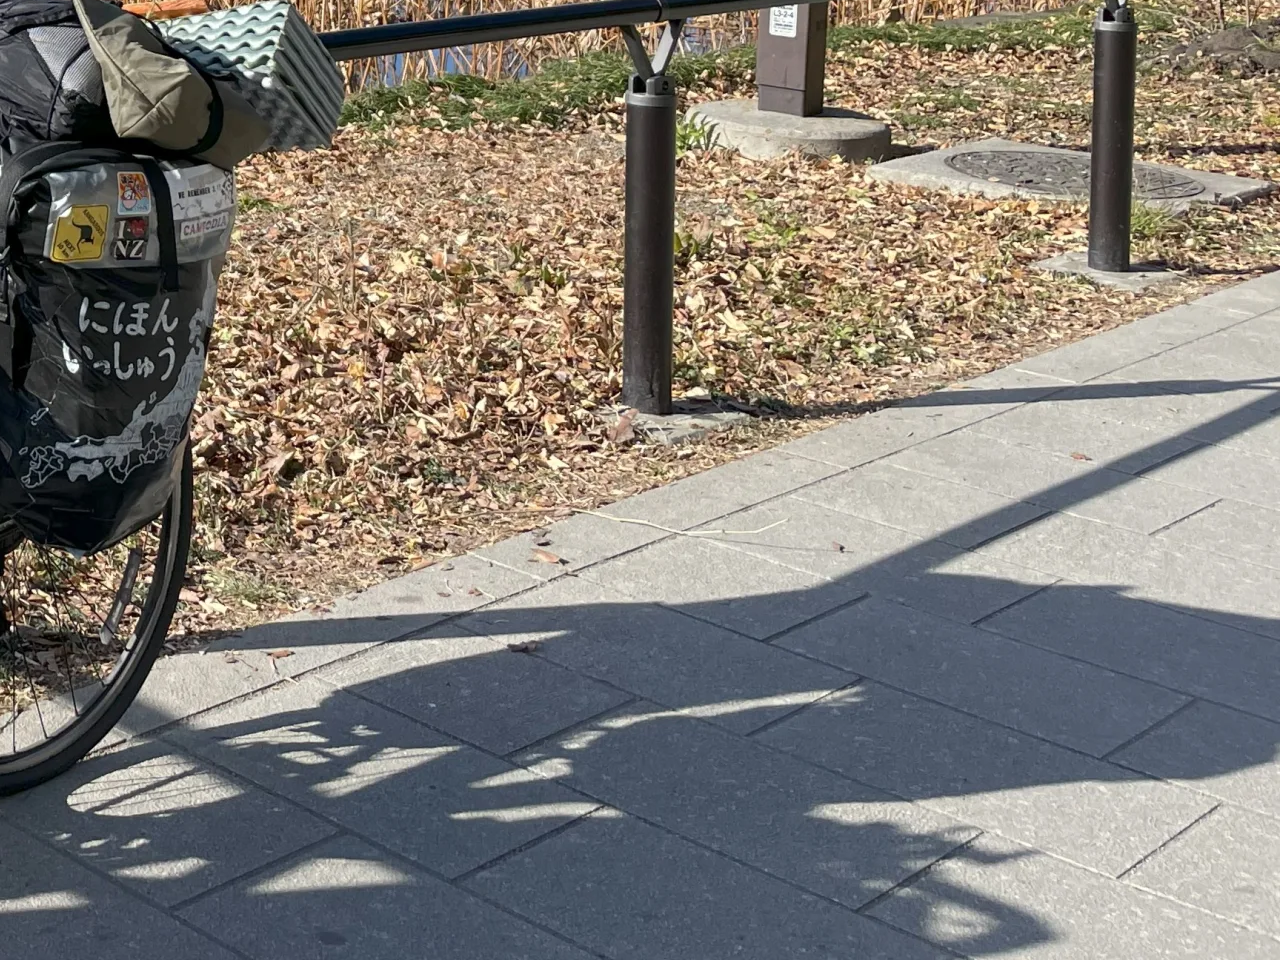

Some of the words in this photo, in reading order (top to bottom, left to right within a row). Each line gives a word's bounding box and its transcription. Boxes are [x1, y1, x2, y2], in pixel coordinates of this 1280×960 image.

[178, 191, 185, 199] WE
[113, 239, 145, 258] NZ
[79, 297, 178, 335] にほん
[62, 337, 176, 381] いっしゅう
